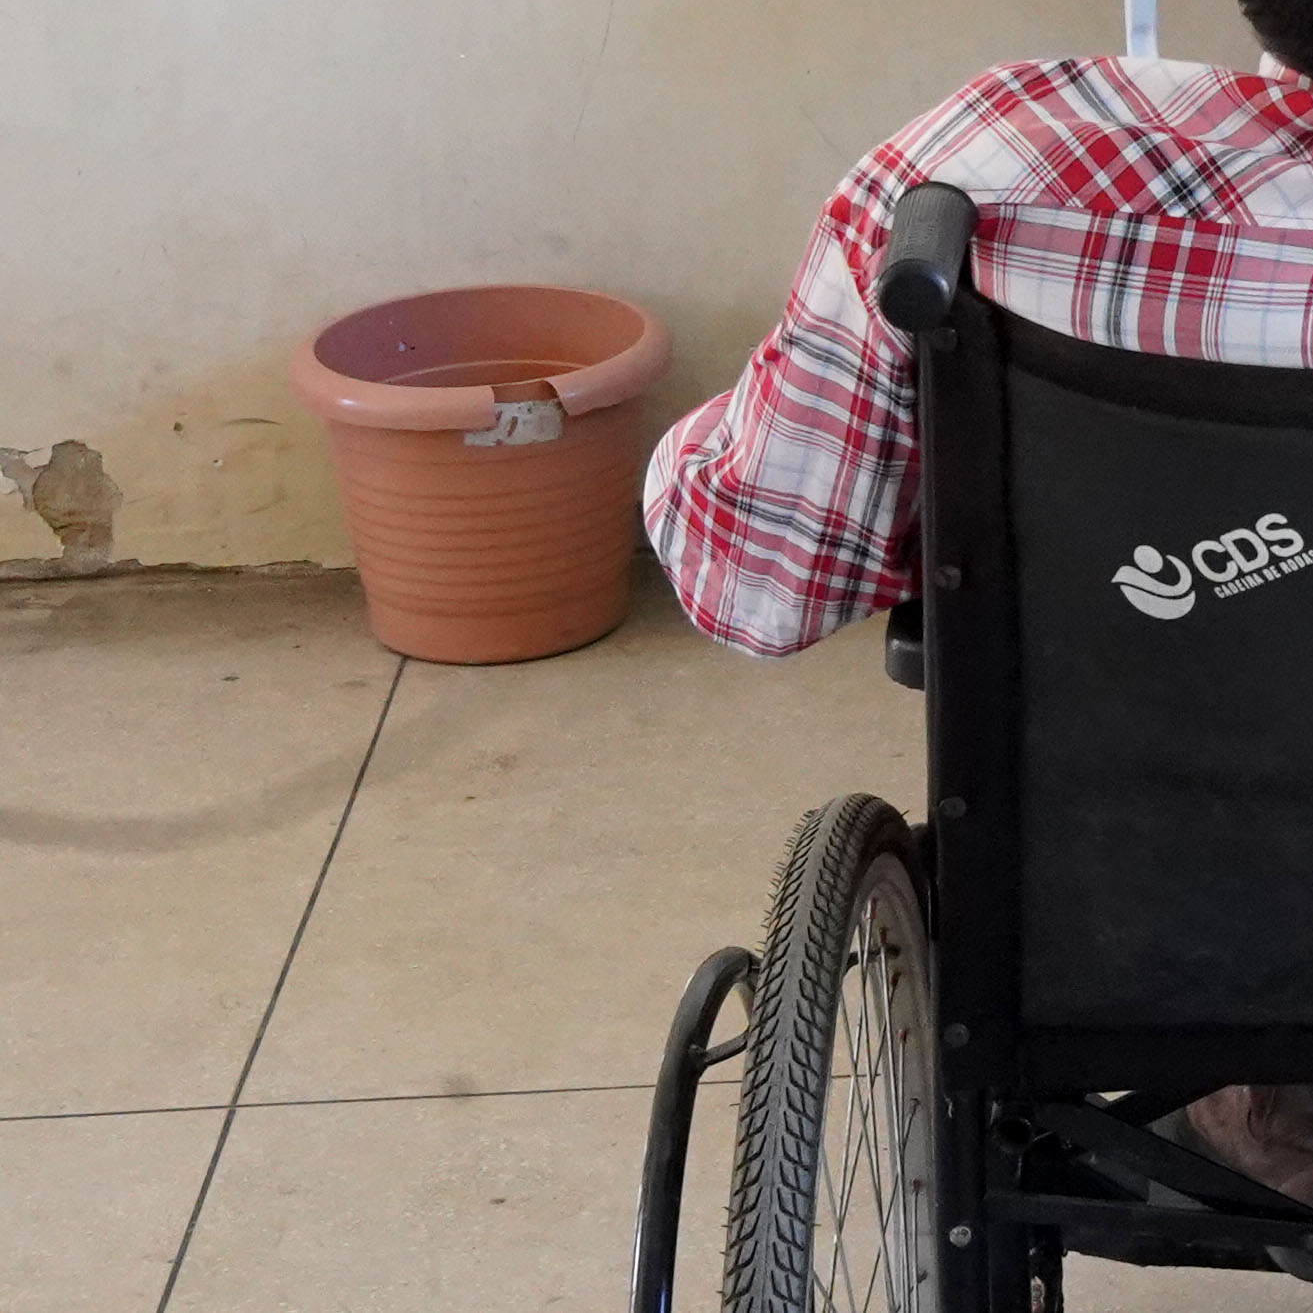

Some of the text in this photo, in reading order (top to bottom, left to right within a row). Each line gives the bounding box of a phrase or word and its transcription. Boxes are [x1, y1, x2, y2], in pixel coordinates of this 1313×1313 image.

[1191, 512, 1305, 583] CDS
[1213, 573, 1265, 599] CADEIRA
[1262, 565, 1282, 582] DE
